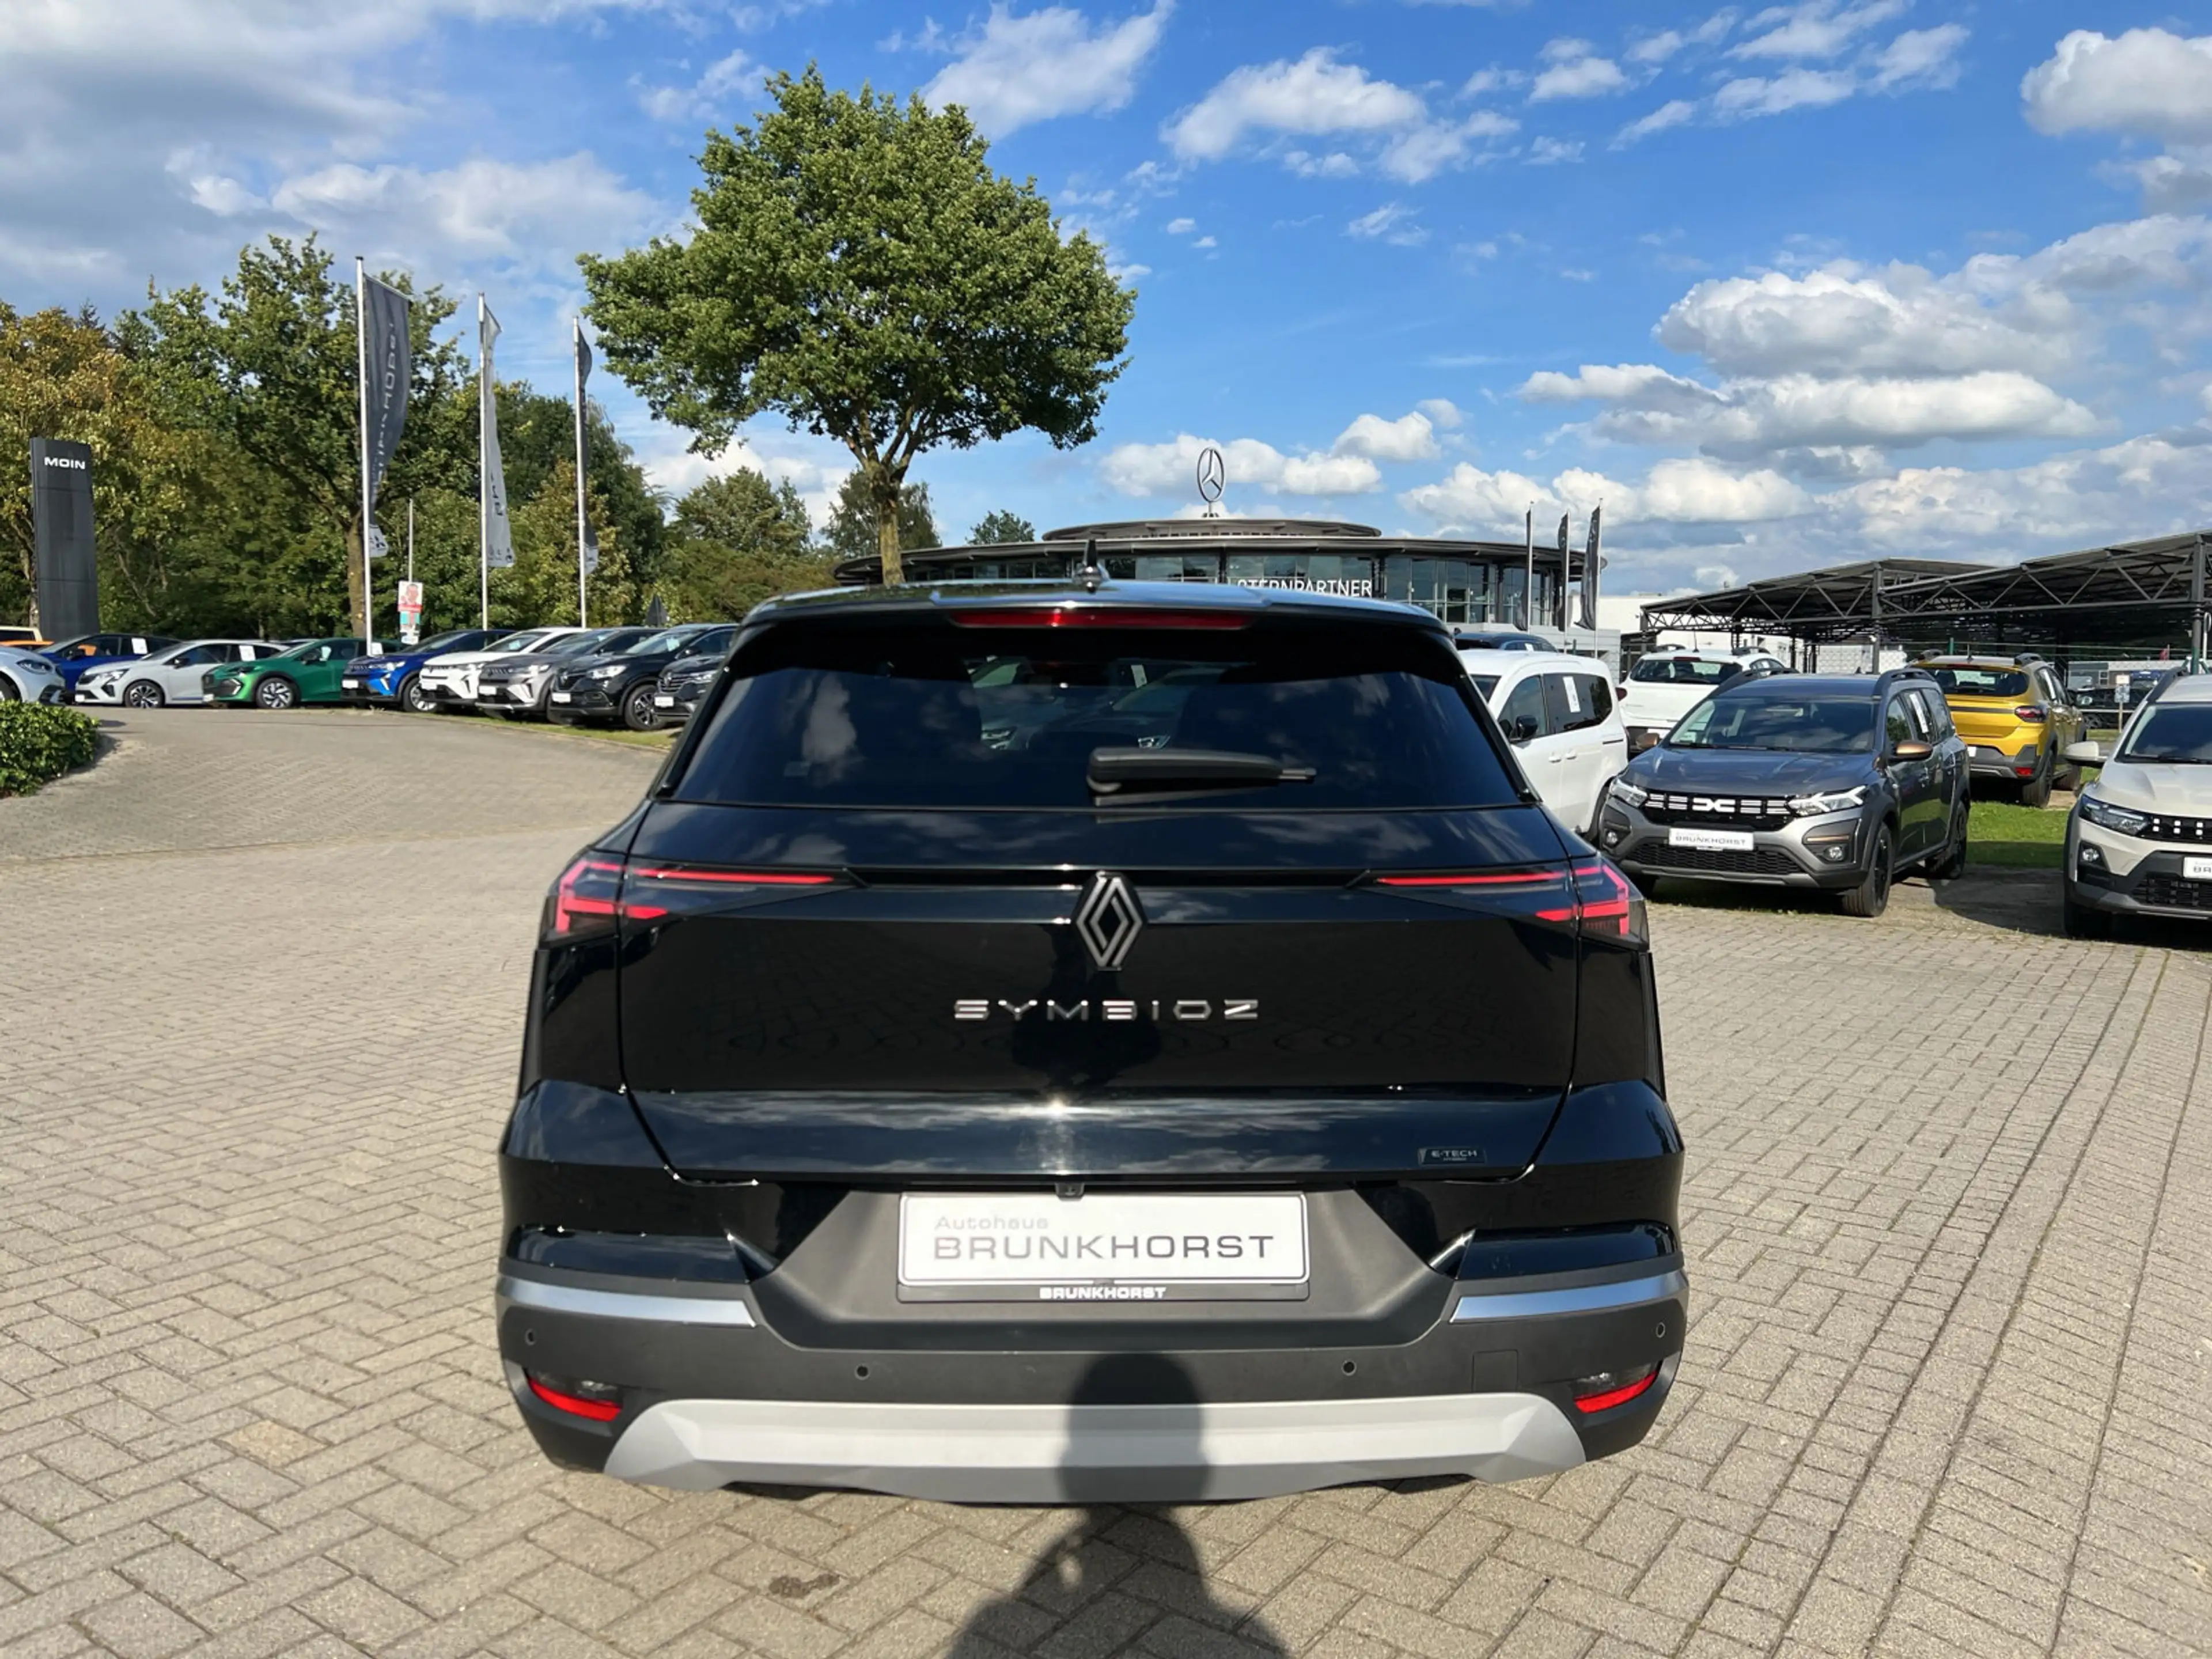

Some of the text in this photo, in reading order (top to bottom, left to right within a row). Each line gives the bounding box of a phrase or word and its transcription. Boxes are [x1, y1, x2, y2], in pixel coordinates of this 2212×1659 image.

[44, 456, 85, 469] MOIN
[954, 999, 1259, 1021] SYMBIOZ
[934, 1215, 1049, 1230] Autohaus
[934, 1235, 1274, 1259] BRUNKHORST
[1039, 1286, 1167, 1300] BRUNKHORST
